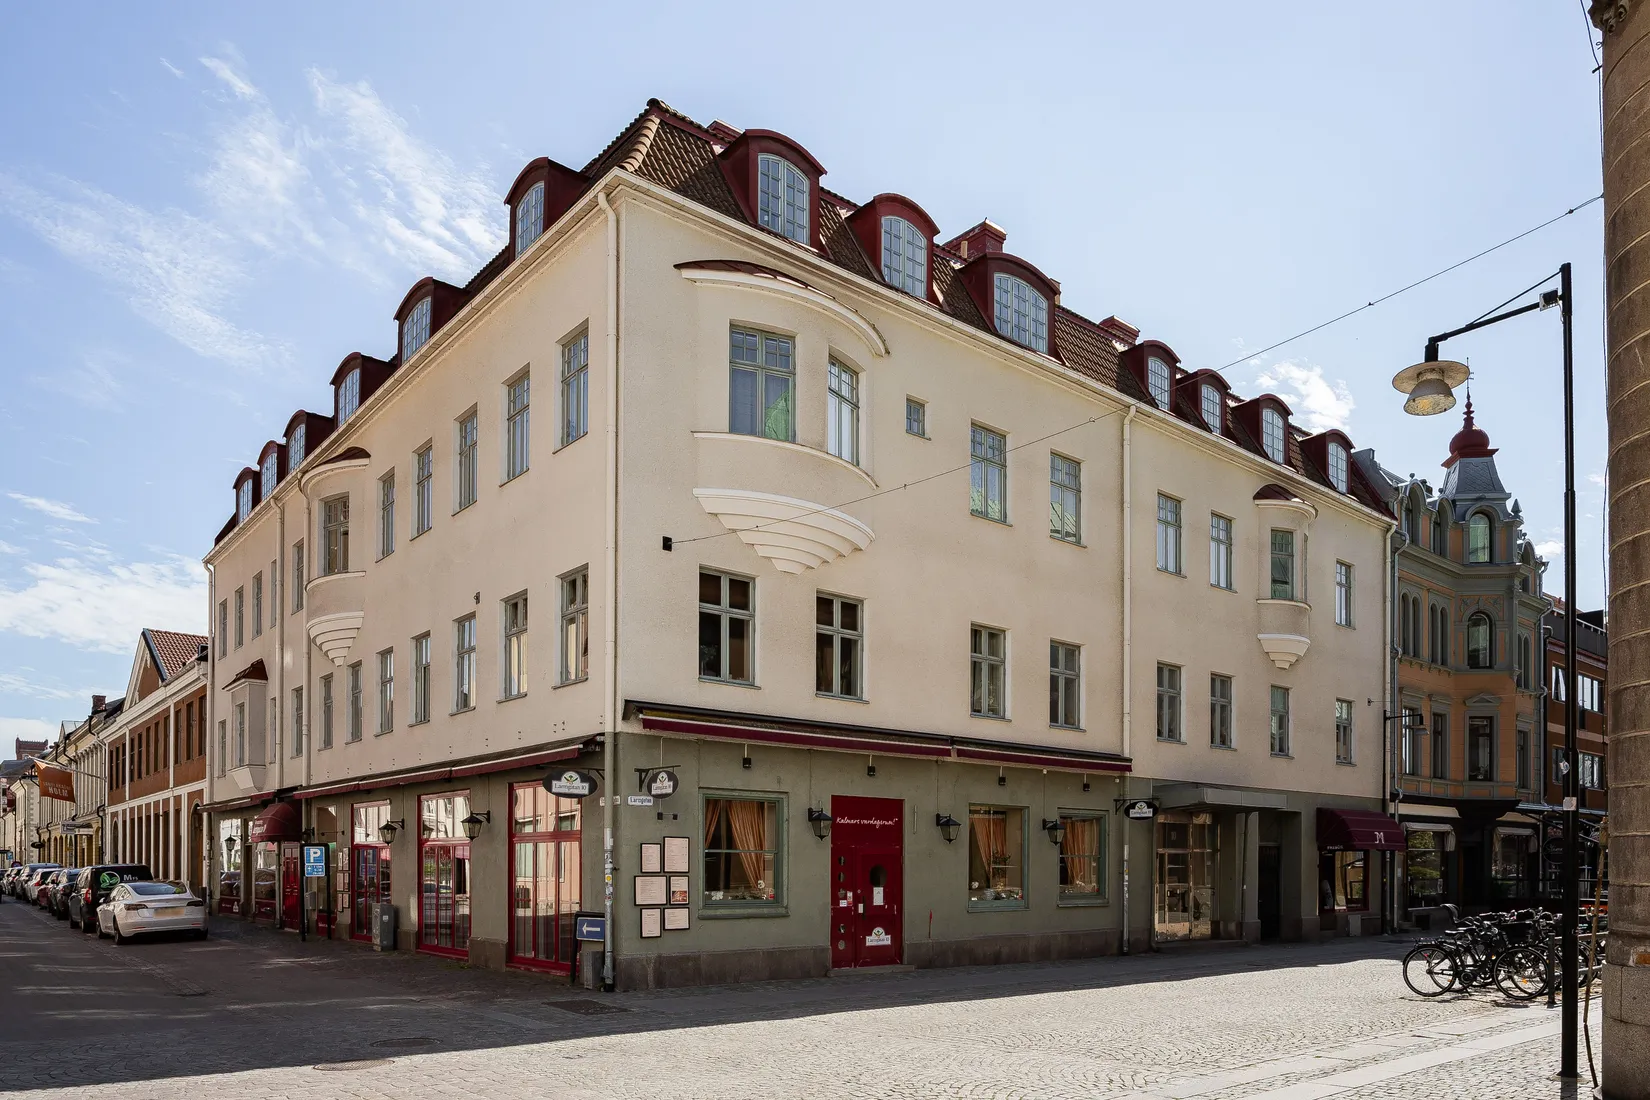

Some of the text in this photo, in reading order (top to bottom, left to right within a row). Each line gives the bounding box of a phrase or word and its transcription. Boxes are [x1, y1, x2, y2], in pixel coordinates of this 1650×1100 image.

[48, 786, 69, 797] HOLM
[836, 816, 860, 824] Kalmars
[309, 848, 321, 862] P
